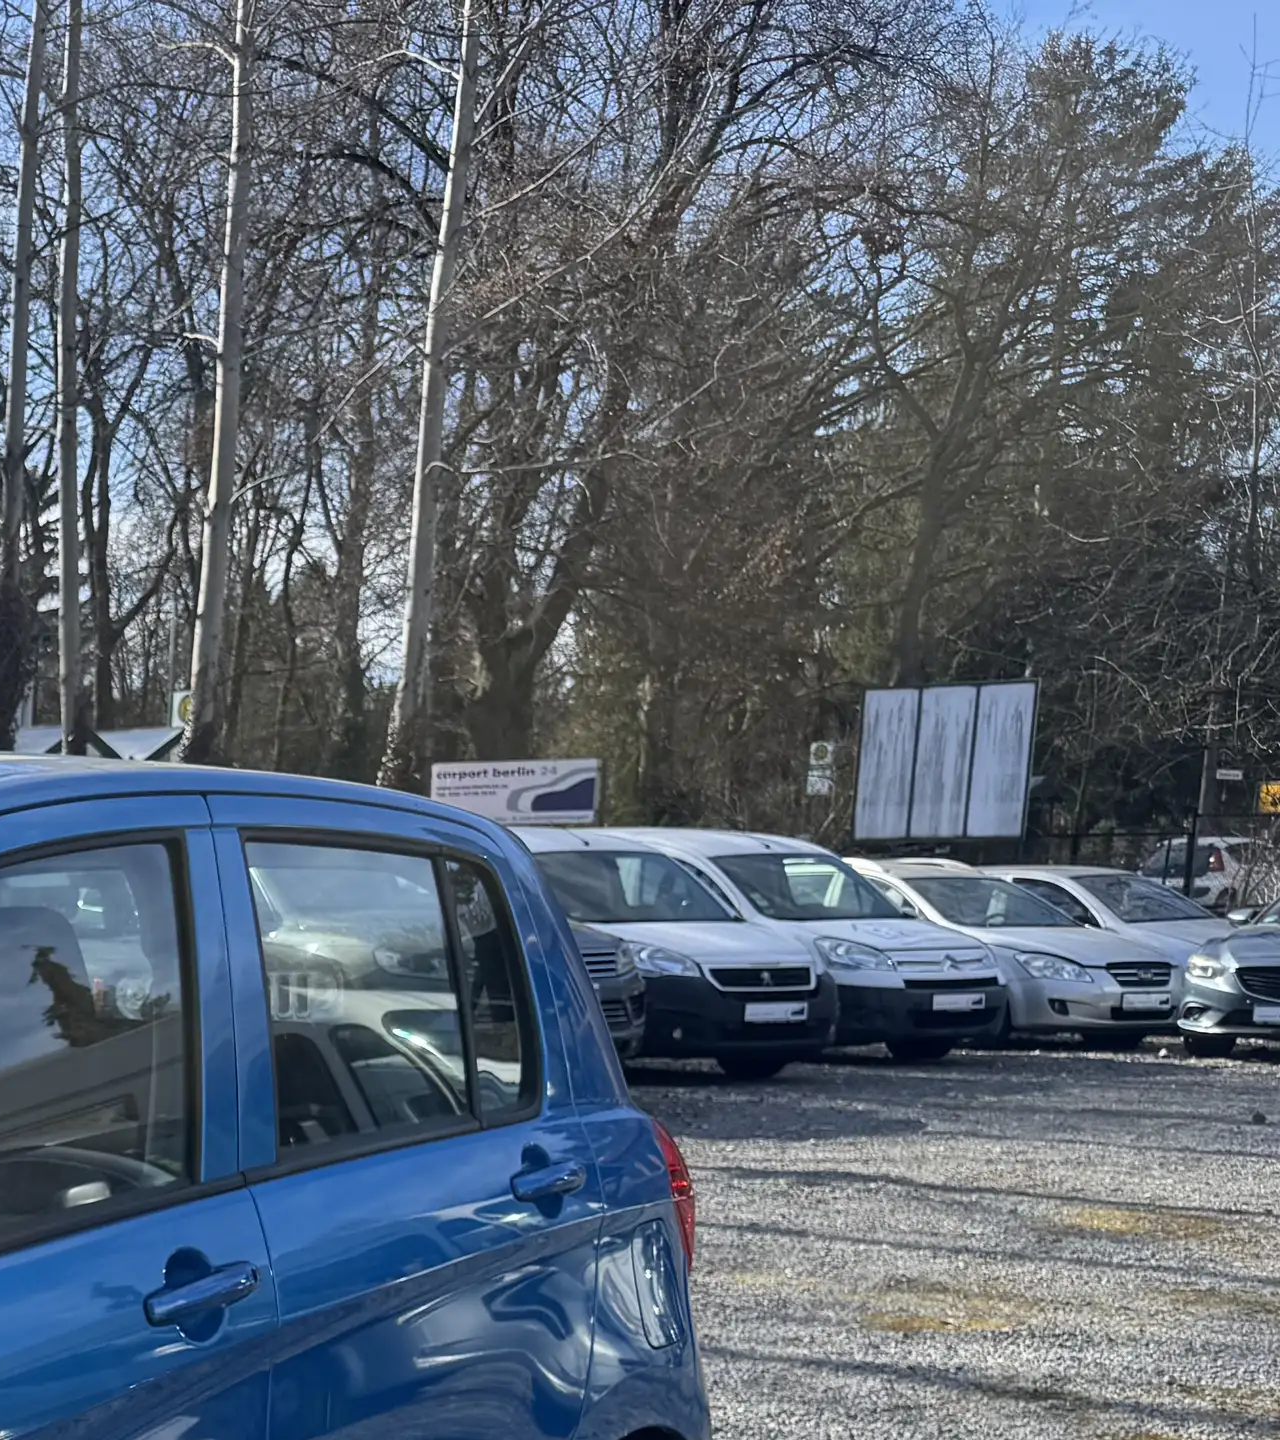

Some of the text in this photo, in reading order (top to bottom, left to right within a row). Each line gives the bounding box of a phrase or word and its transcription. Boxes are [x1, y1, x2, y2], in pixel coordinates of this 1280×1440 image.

[436, 766, 557, 781] carport berlin 24
